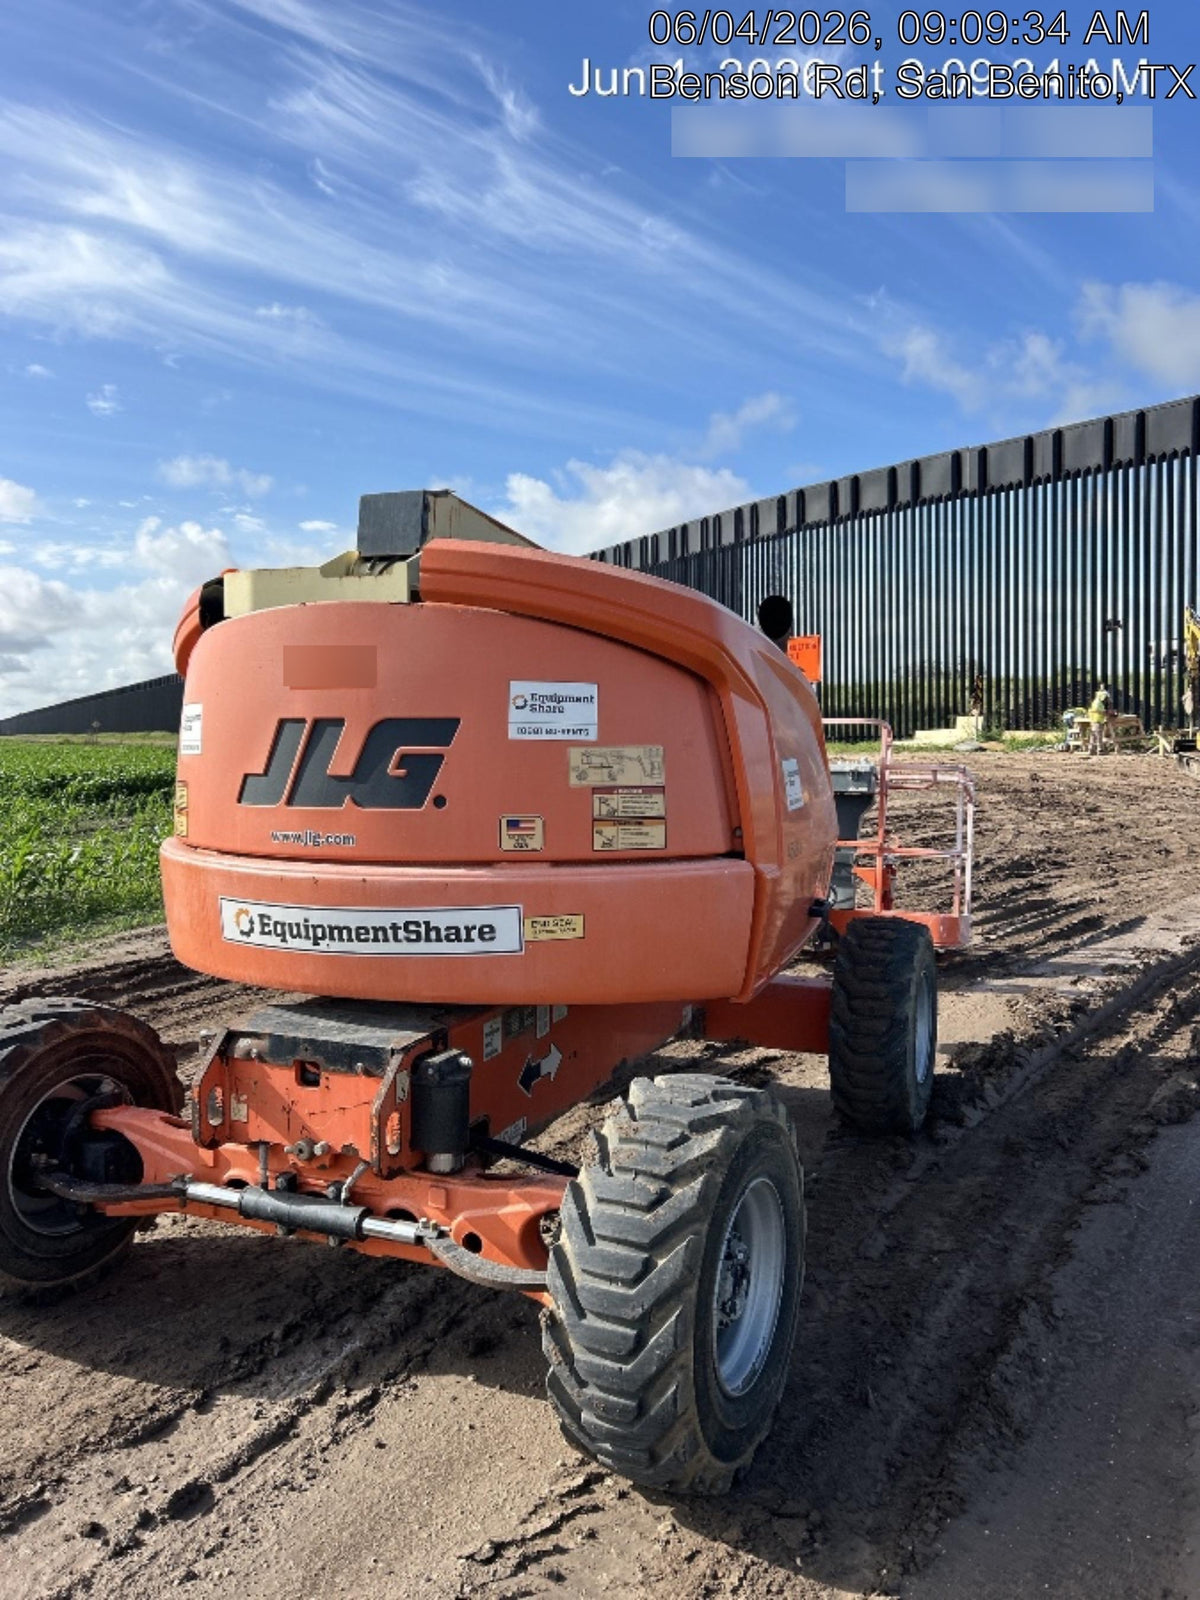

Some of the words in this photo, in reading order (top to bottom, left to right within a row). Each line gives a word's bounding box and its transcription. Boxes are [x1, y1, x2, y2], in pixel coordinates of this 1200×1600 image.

[529, 703, 565, 714] Share
[271, 830, 355, 847] www.jlg.com
[258, 912, 497, 946] EquipmentShare
